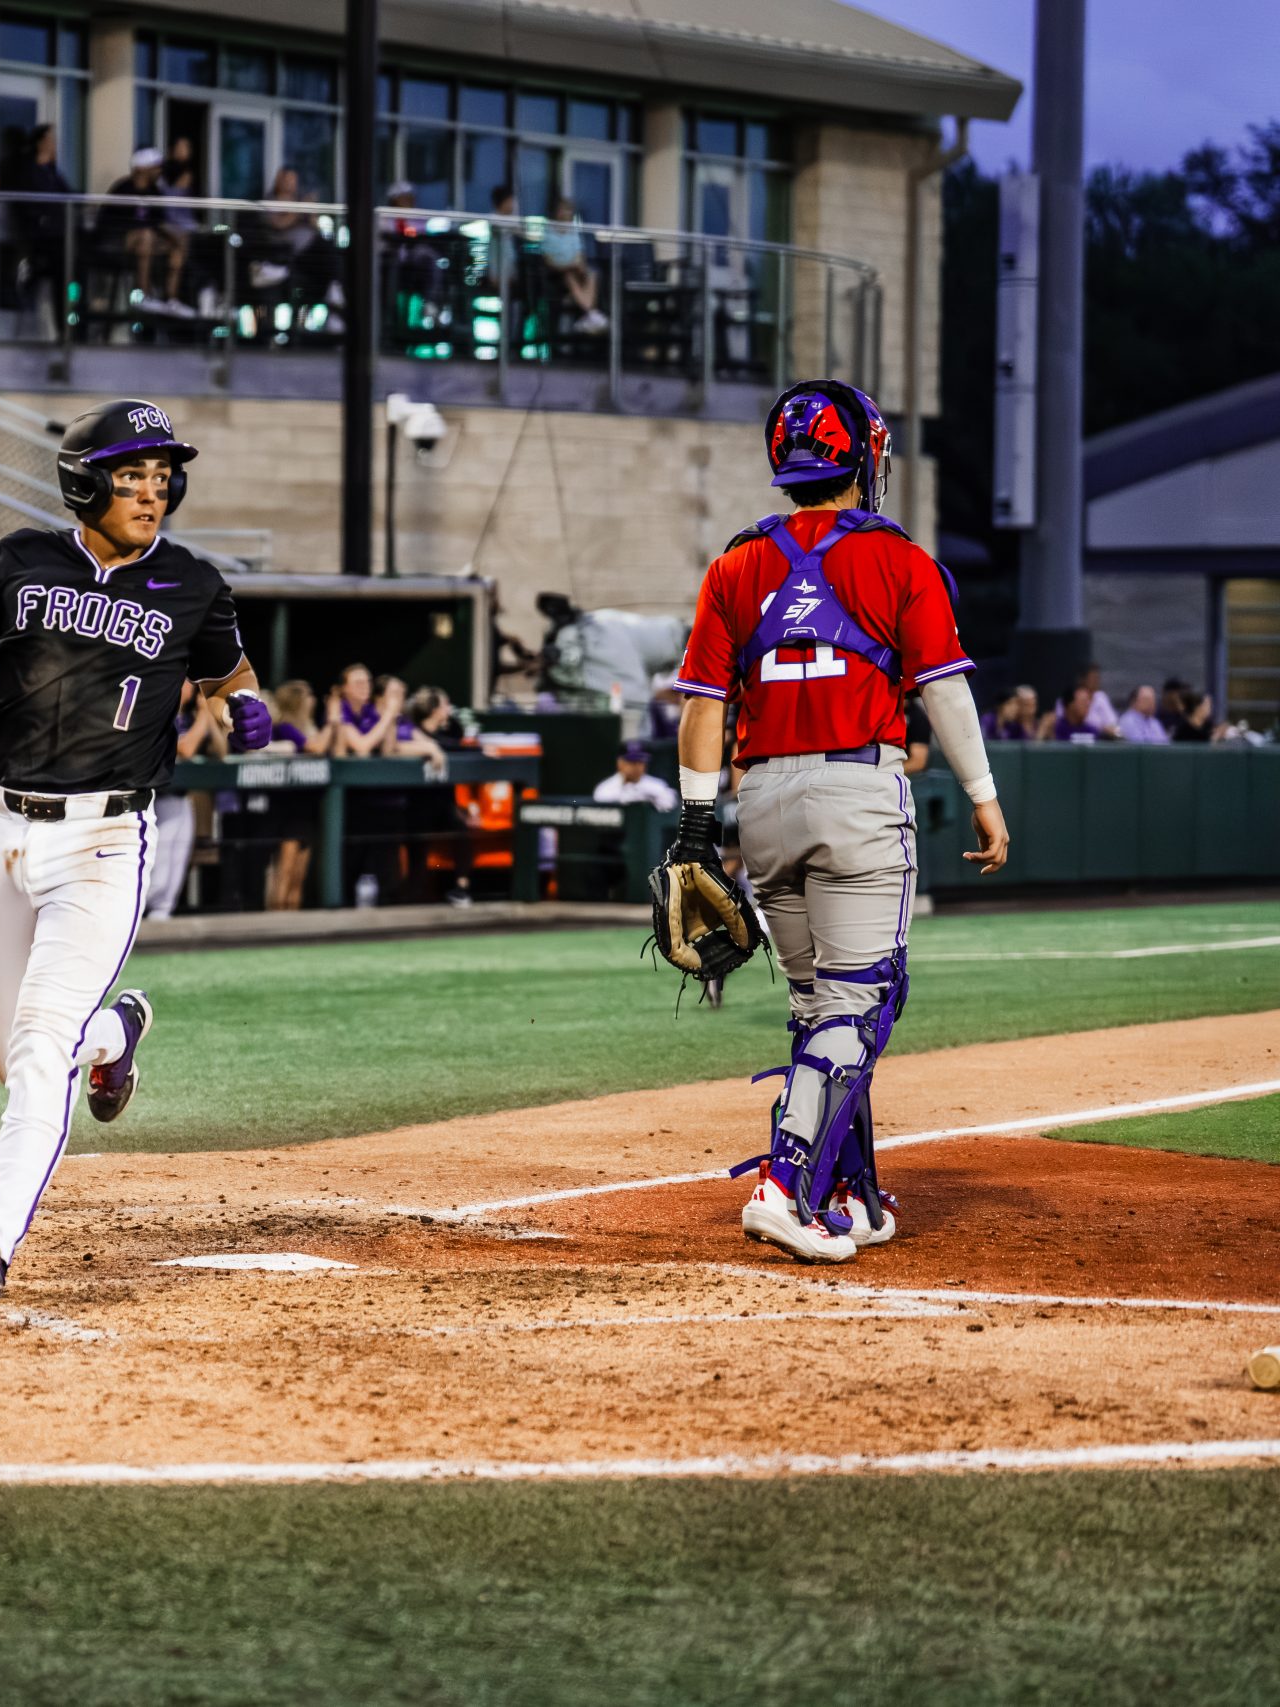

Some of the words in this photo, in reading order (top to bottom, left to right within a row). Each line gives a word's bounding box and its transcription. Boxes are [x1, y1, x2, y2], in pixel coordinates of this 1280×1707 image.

[127, 406, 173, 434] TCU
[16, 584, 173, 660] FROGS
[112, 674, 142, 732] 1
